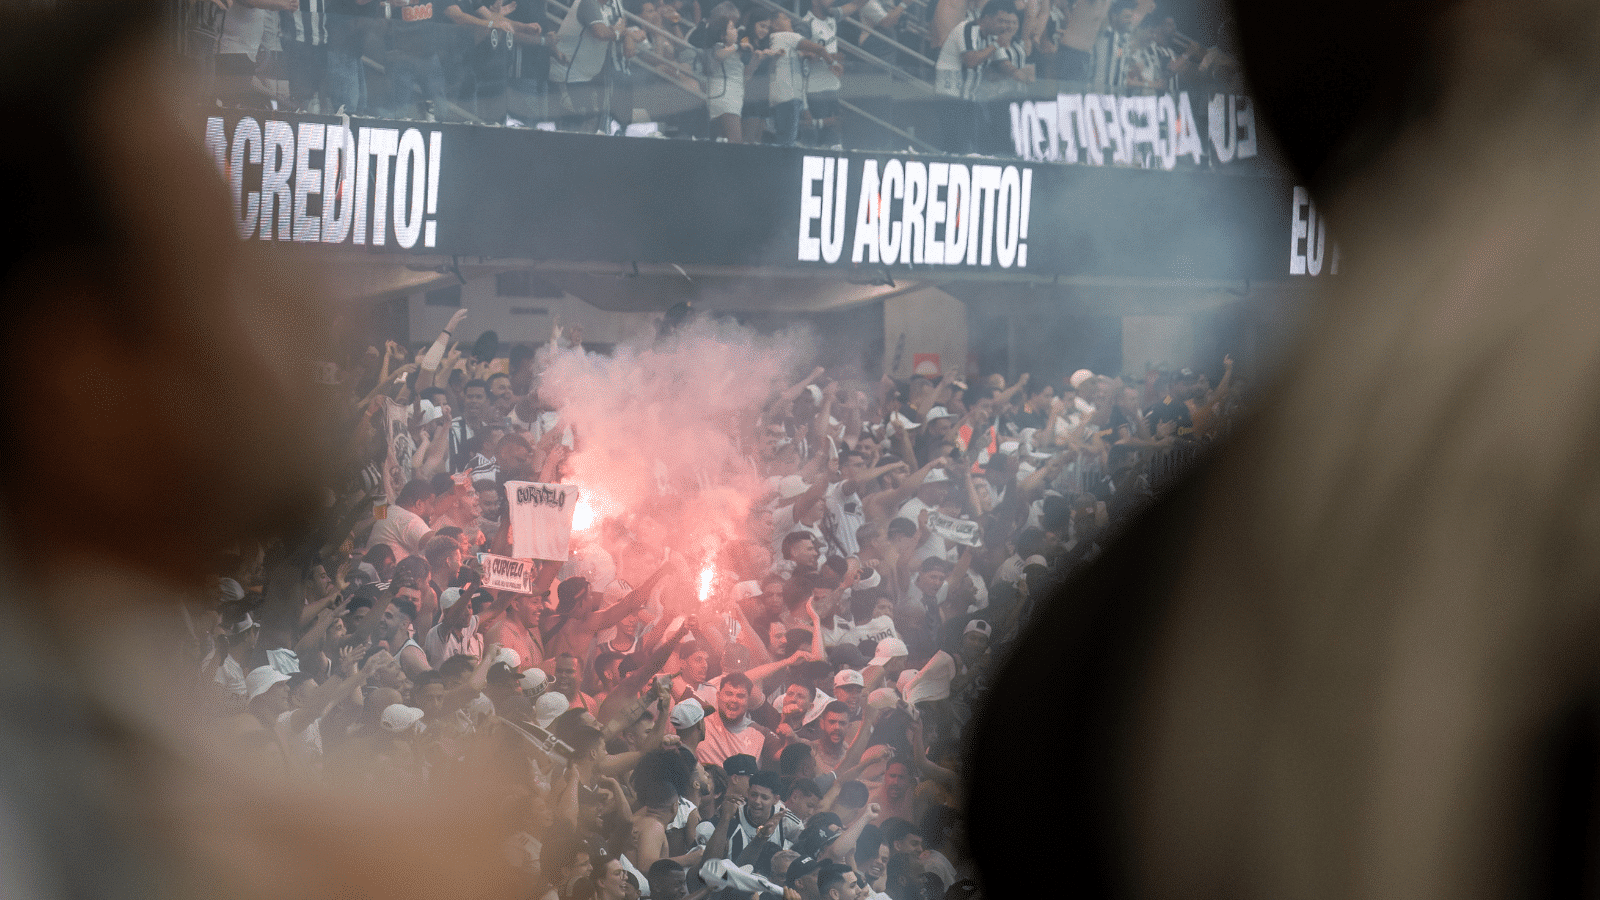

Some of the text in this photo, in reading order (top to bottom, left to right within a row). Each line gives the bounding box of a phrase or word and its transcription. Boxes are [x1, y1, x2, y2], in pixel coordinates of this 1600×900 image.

[798, 155, 1033, 268] EU ACREDITO!
[1290, 186, 1325, 277] EU
[517, 485, 566, 510] CURVELO
[492, 558, 524, 578] CURVELO
